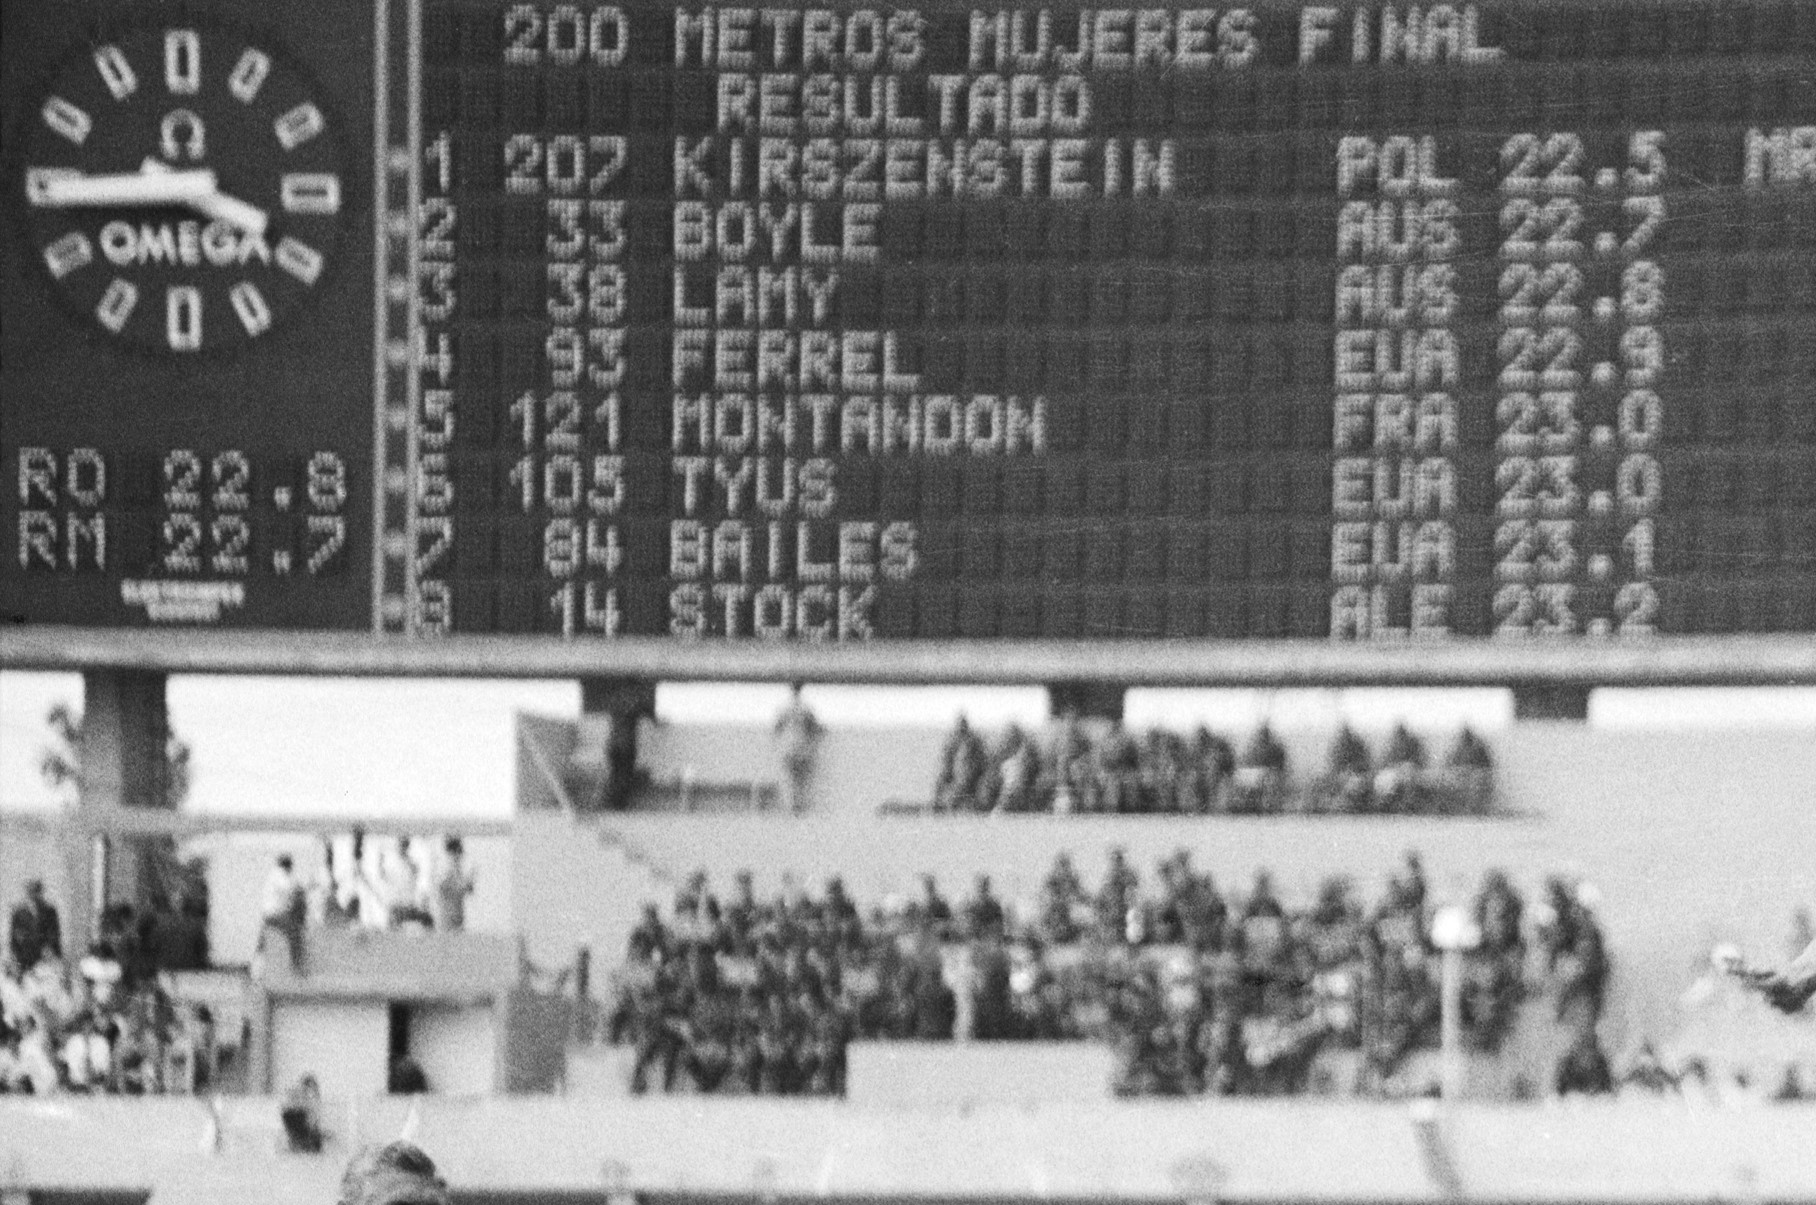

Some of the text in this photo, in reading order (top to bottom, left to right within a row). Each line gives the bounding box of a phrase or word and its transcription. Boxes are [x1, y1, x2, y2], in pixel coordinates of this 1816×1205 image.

[505, 5, 1506, 69] 200 METROS MUJERES FINAL
[716, 72, 1092, 133] RESULTADO
[426, 130, 451, 192] 1
[505, 134, 627, 194] 207
[673, 136, 1176, 199] KIRSZENSTEIN
[1337, 135, 1460, 196] POL
[1497, 131, 1666, 196] 22.5
[99, 219, 272, 267] OMEGA
[417, 196, 1666, 262] 2 33 BOYLE AUS 22.7
[417, 261, 1665, 326] 3 38 LAMY AUS 22.8
[545, 327, 627, 389] 93
[672, 330, 920, 390] FERREL
[1496, 326, 1664, 391] 22.9
[417, 389, 1663, 456] 5 121 MONTANDON FRA 23.0
[18, 447, 347, 512] RO 22.8
[417, 452, 453, 513] 6
[510, 454, 625, 513] 105
[672, 456, 836, 518] TYUS
[1494, 454, 1662, 518] 23.0
[18, 510, 346, 575] RM 22.7
[415, 515, 452, 576] 7
[543, 518, 620, 578] 84
[670, 519, 919, 581] BAILES
[1493, 517, 1655, 582] 23.1
[550, 581, 620, 638] 14
[670, 583, 876, 641] STOCK
[1330, 583, 1453, 640] ALE
[1492, 582, 1660, 640] 23.2
